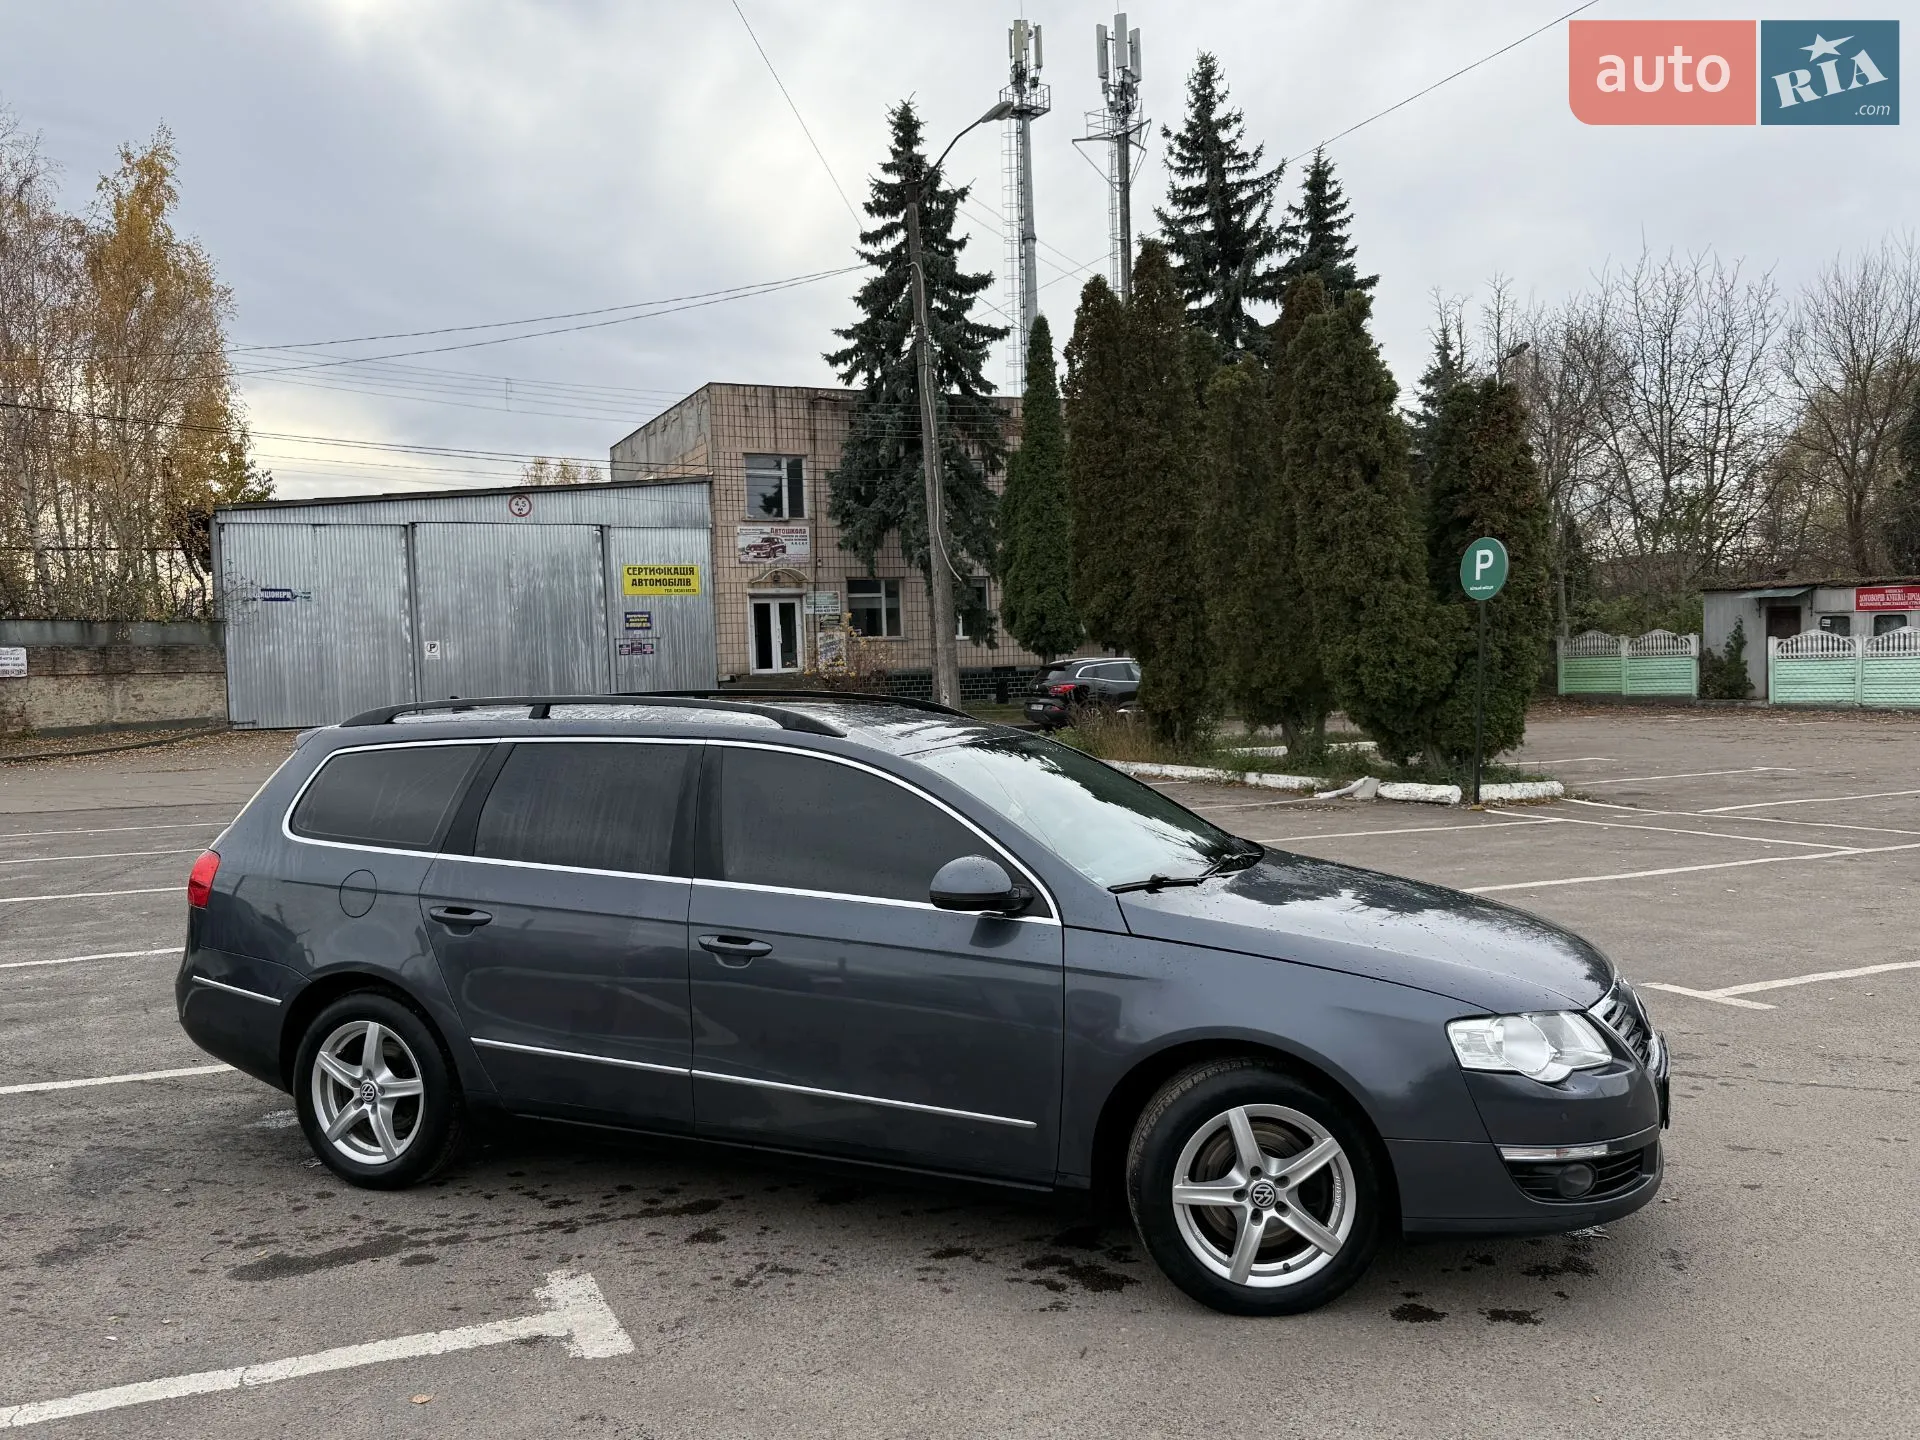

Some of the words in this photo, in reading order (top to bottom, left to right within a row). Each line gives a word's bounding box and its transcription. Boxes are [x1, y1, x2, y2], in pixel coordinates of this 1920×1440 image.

[1475, 549, 1494, 581] P
[626, 567, 695, 576] СЕРТИФІКАЦІЯ
[631, 578, 692, 587] АВТОМОБІЛІВ
